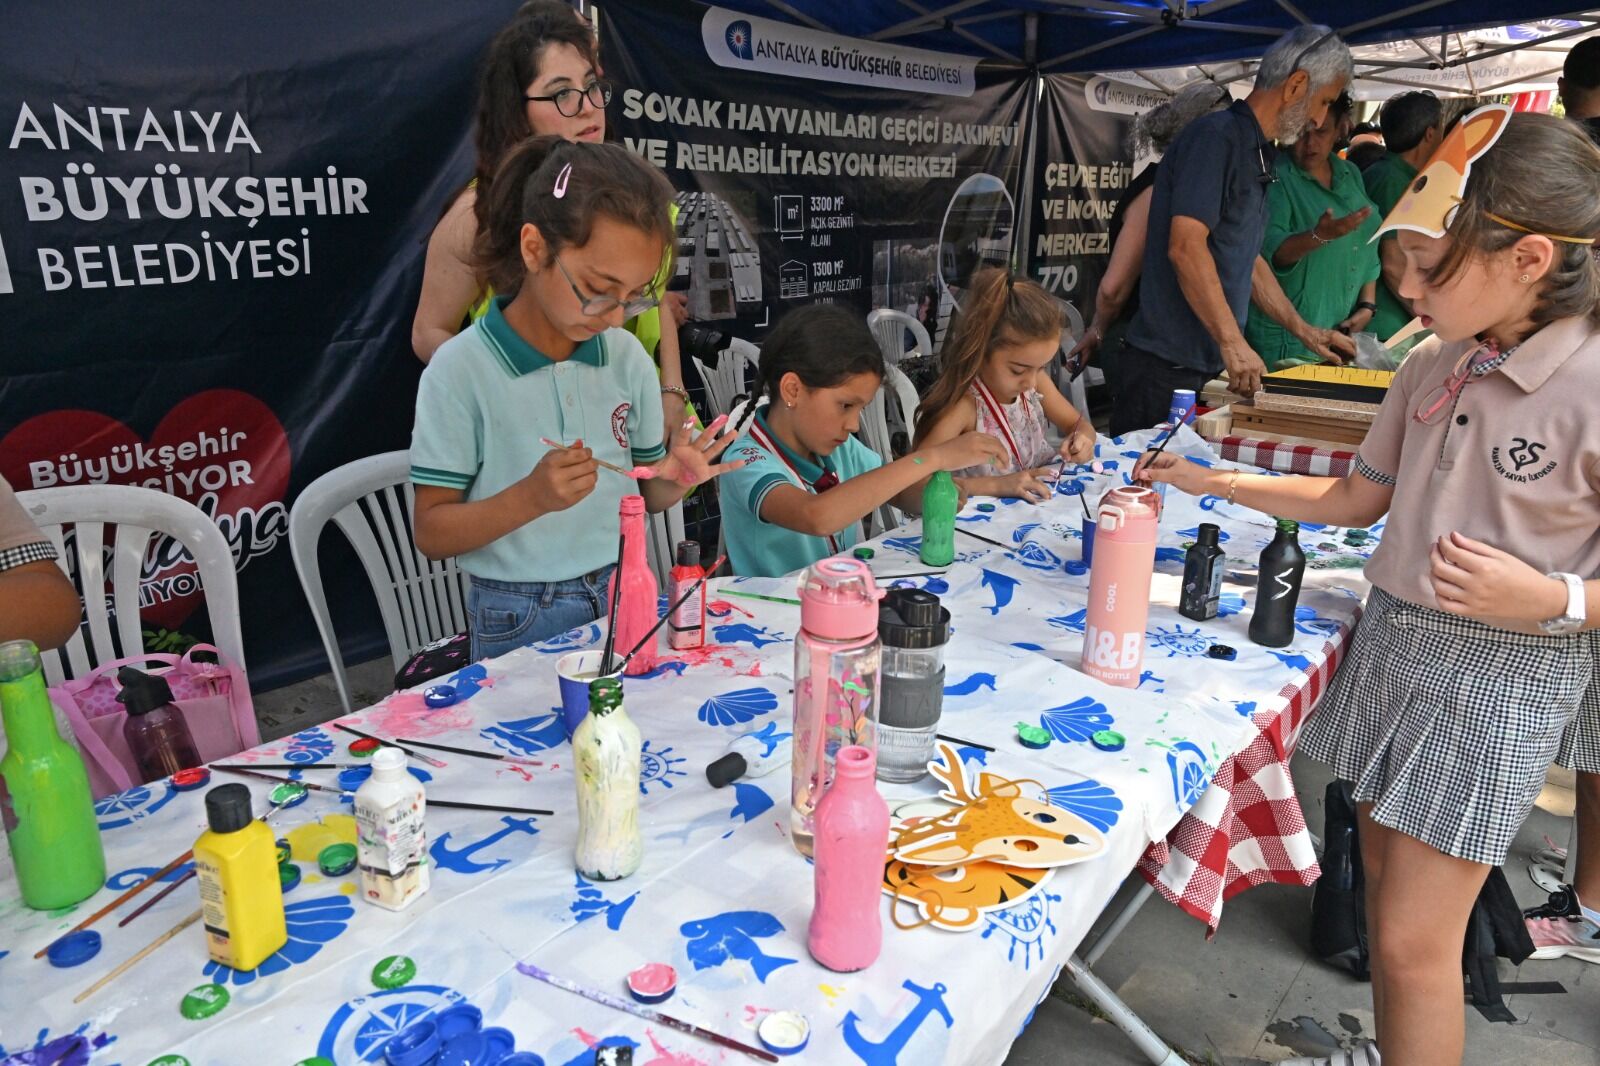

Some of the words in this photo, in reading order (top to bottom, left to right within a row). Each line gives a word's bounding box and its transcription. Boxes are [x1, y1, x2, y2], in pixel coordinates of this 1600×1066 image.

[756, 38, 818, 66] ANTALYA
[821, 46, 902, 78] BÜYÜKŞEHİR
[905, 64, 962, 85] BELEDİYESİ
[1107, 90, 1136, 106] ANTALYA
[9, 101, 262, 154] ANTALYA
[622, 88, 722, 130] SOKAK
[728, 102, 877, 140] HAYVANLARI
[881, 116, 940, 147] GEÇİCİ
[624, 138, 667, 169] VE
[676, 139, 875, 177] REHABİLİTASYON
[879, 152, 957, 179] MERKEZİ
[1045, 162, 1098, 191] ÇEVRE
[1100, 160, 1132, 190] EĞİT
[19, 162, 370, 228] BÜYÜKŞEHİR
[810, 196, 832, 212] 3300
[1042, 199, 1064, 220] VE
[1066, 194, 1119, 220] İNOVAS
[810, 216, 827, 232] AÇIK
[828, 213, 854, 229] GEZİNTİ
[810, 234, 831, 247] ALANI
[37, 227, 311, 291] BELEDİYESİ
[812, 261, 833, 277] 1300
[813, 279, 836, 294] KAPALI
[837, 274, 862, 291] GEZİNTİ
[1038, 264, 1078, 292] 770
[29, 427, 247, 488] Büyükşehir
[1106, 583, 1117, 612] COOL
[1103, 671, 1130, 680] BOTTLE
